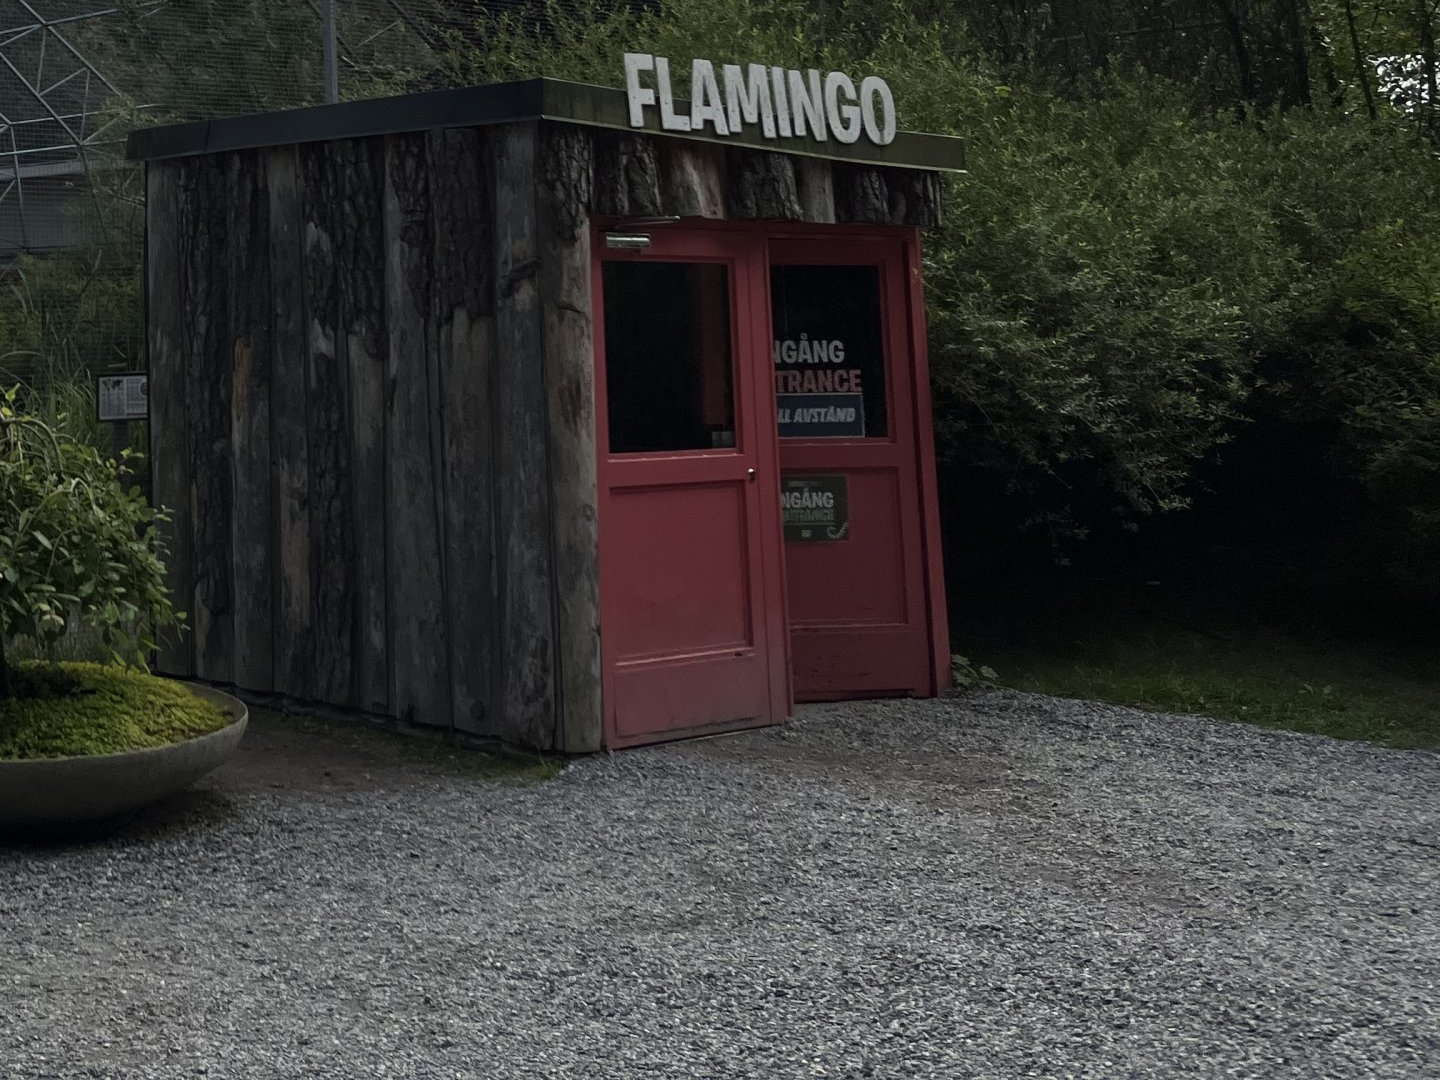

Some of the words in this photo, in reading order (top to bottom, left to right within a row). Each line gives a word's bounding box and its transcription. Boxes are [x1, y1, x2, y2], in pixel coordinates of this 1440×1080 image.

[624, 52, 896, 146] FLAMINGO
[776, 369, 863, 393] TRANCE
[793, 406, 856, 423] AVSTÅND
[781, 487, 835, 508] NGÅNG
